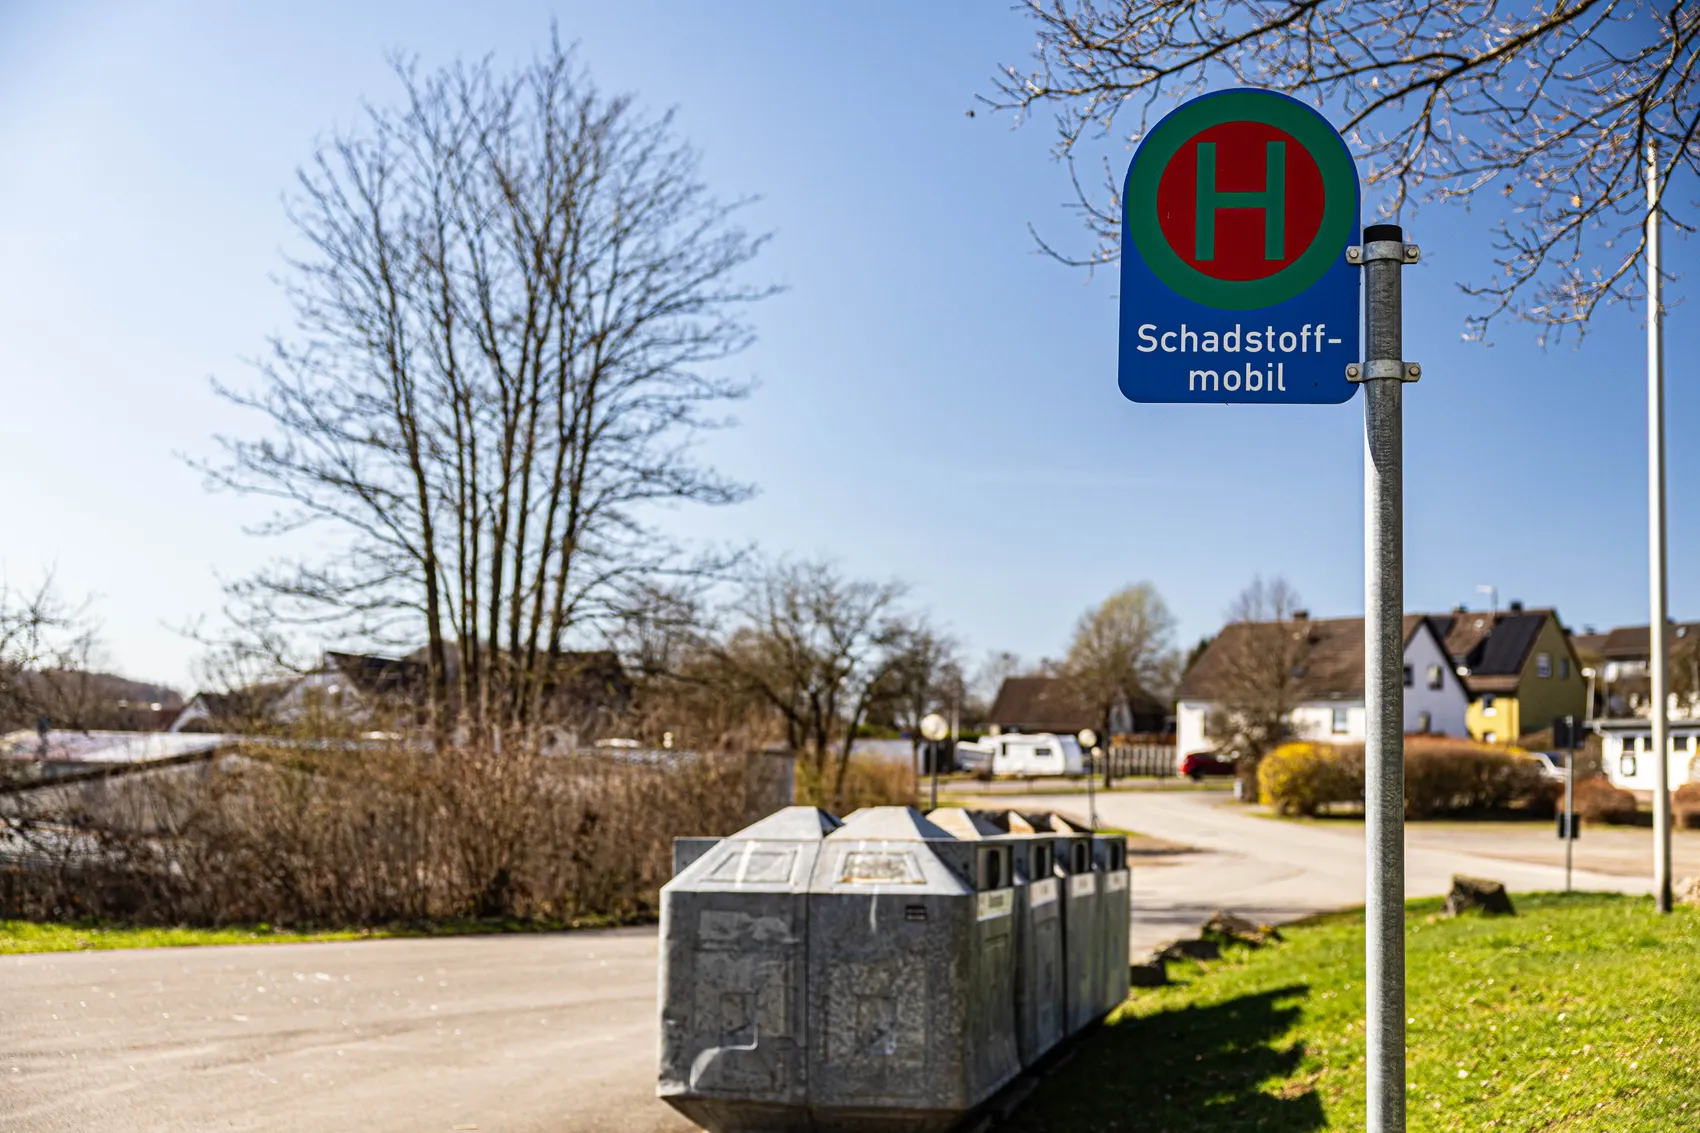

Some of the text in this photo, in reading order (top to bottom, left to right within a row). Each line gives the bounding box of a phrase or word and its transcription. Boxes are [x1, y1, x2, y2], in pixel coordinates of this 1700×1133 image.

[1195, 141, 1286, 261] H
[1136, 323, 1342, 353] Schadstoff-
[1189, 362, 1286, 391] mobil
